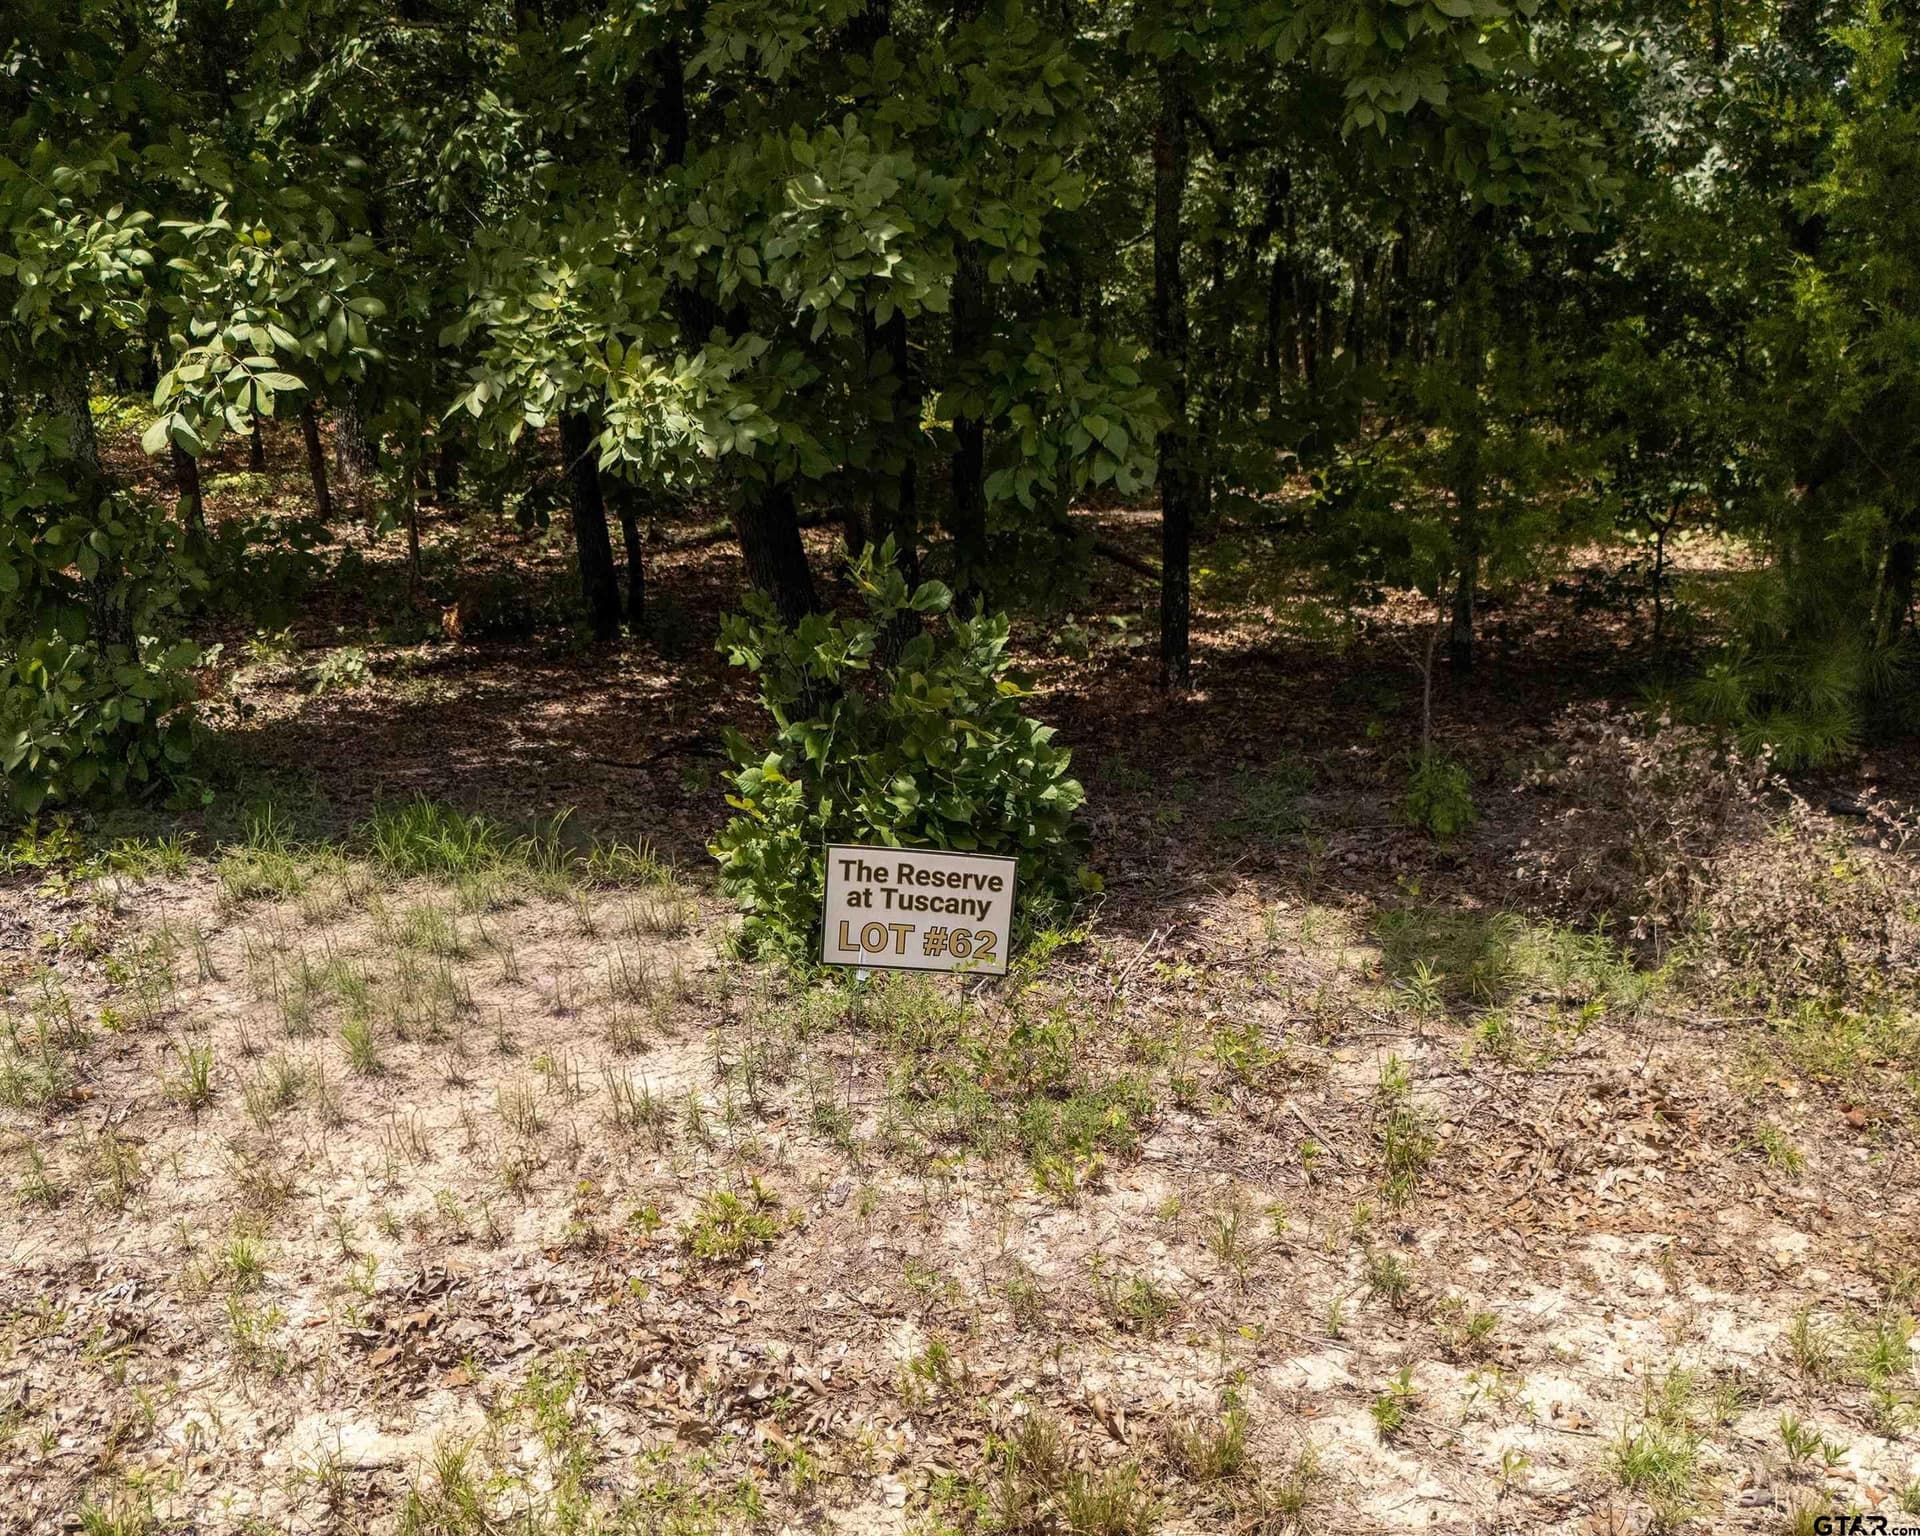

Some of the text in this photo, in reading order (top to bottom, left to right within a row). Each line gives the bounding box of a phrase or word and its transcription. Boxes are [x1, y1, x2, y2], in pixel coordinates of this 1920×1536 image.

[838, 859, 1004, 892] The Reserve
[847, 887, 993, 921] at Tuscany
[838, 920, 998, 960] LOT #62
